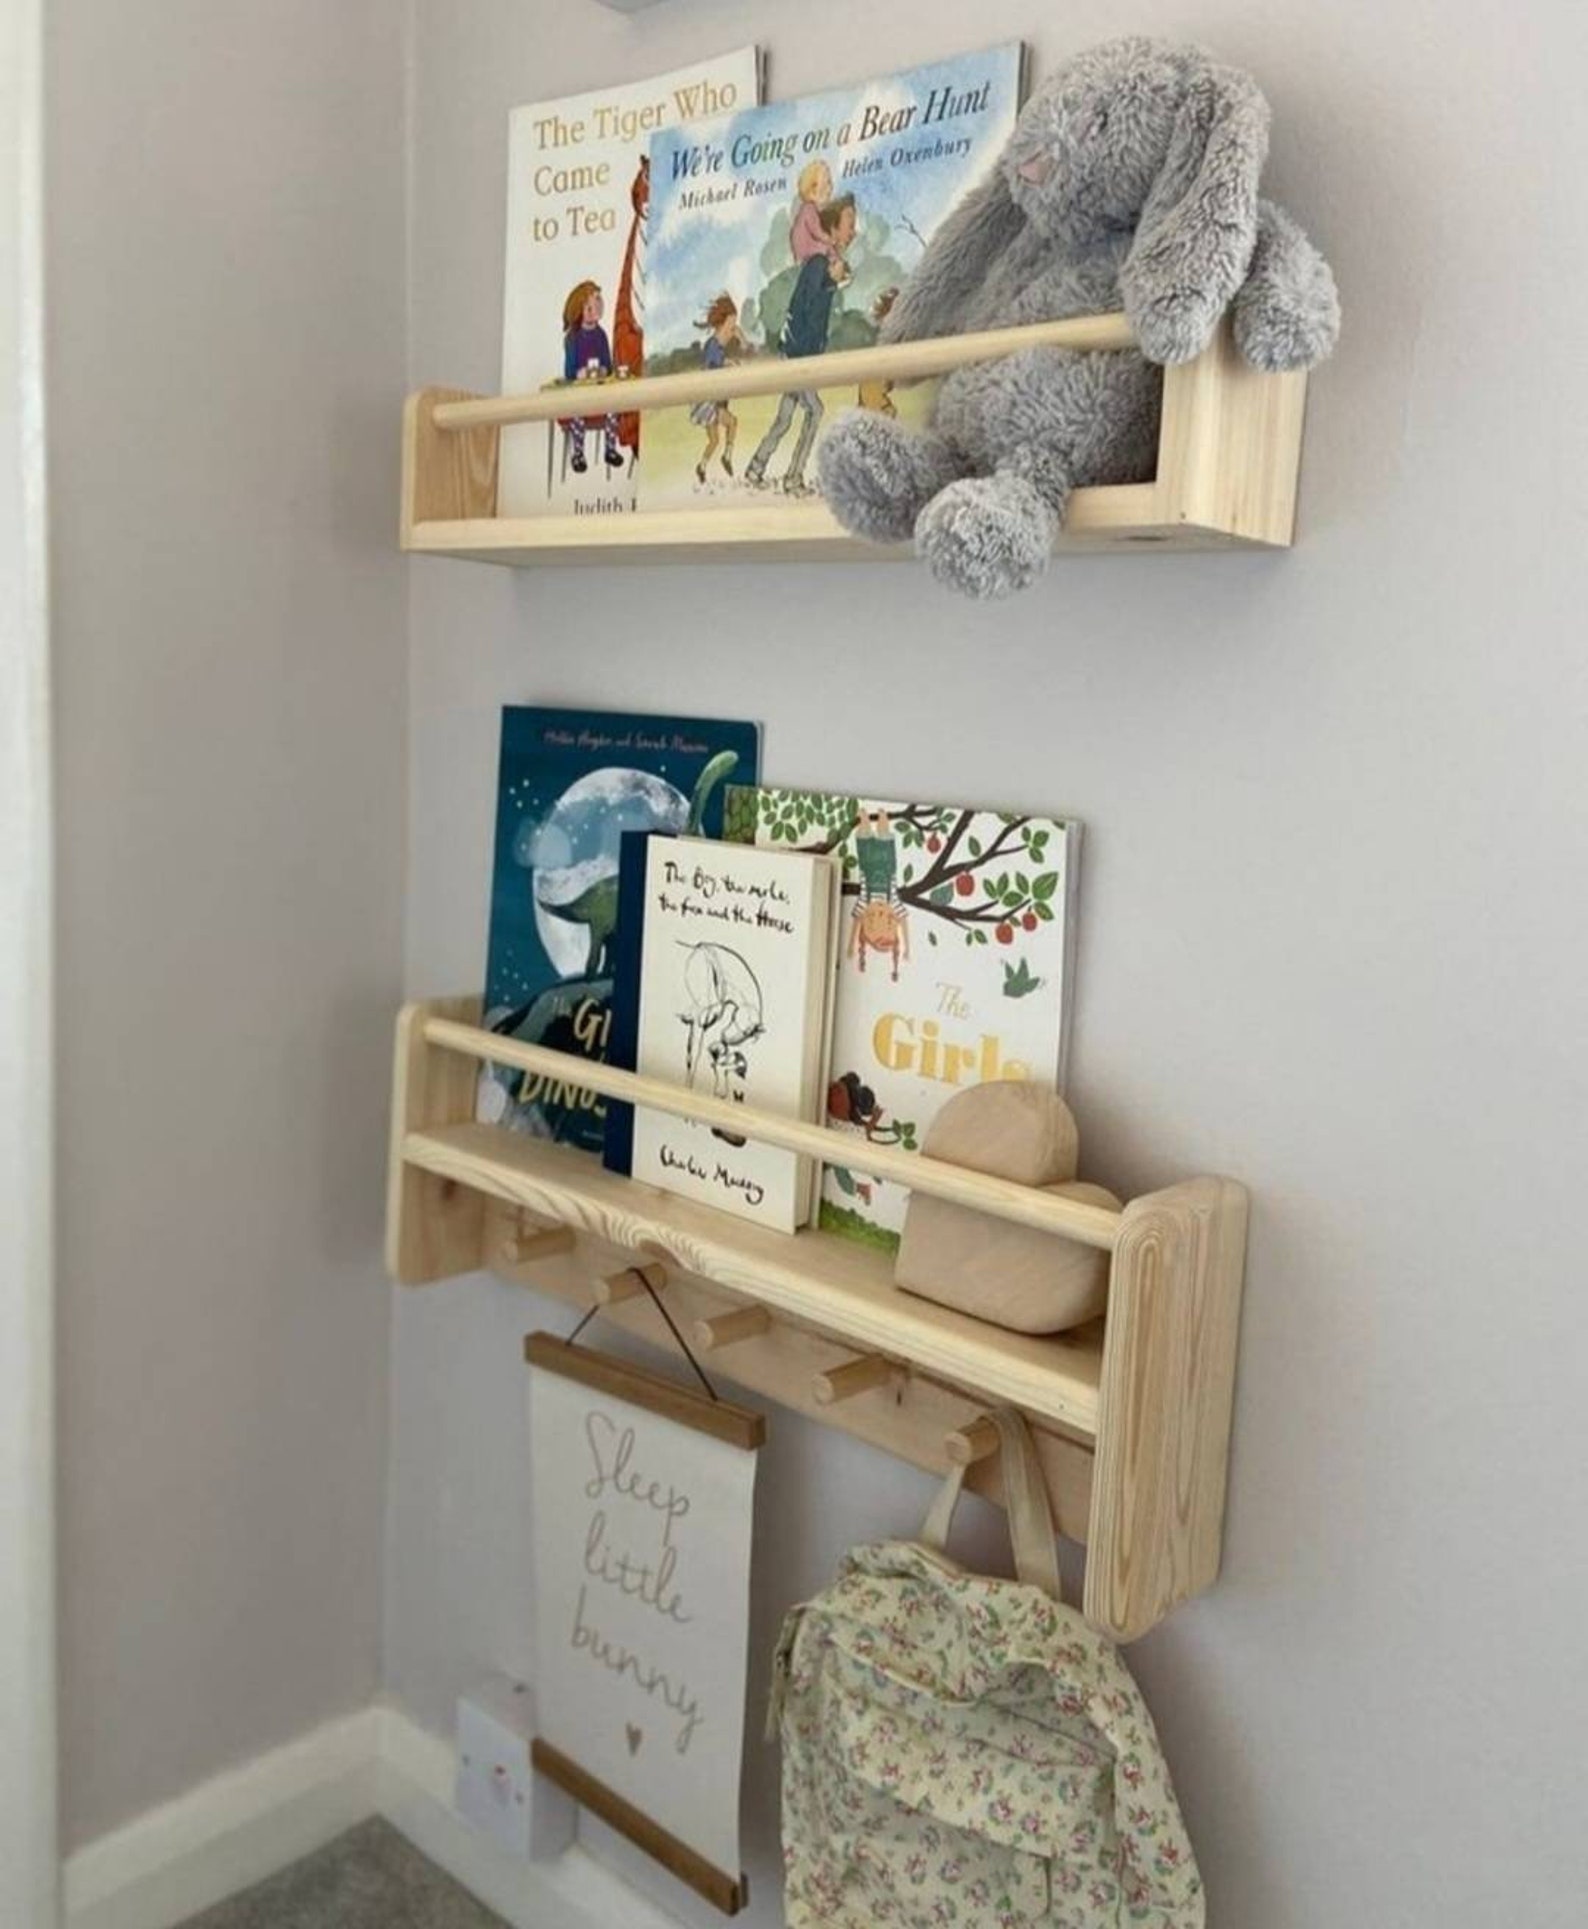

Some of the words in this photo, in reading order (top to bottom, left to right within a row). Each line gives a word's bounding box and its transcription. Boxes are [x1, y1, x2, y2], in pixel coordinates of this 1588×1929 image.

[534, 115, 585, 150] The
[594, 104, 666, 142] Tiger
[673, 81, 737, 119] Who
[672, 144, 723, 181] We're
[731, 130, 797, 168] Going
[803, 128, 831, 153] on
[837, 123, 852, 147] a
[859, 104, 917, 141] Bear
[922, 80, 992, 125] Hunt
[534, 162, 611, 196] Came
[842, 155, 884, 180] Helen
[891, 135, 972, 167] Oxenbury
[679, 182, 737, 211] Michael
[744, 175, 788, 199] Rosen
[533, 216, 558, 242] to
[567, 205, 616, 238] Tea
[574, 496, 623, 515] Judith
[936, 981, 971, 1020] The
[584, 1409, 691, 1548] Sleep
[584, 1508, 694, 1624] little
[570, 1582, 705, 1756] bunny
